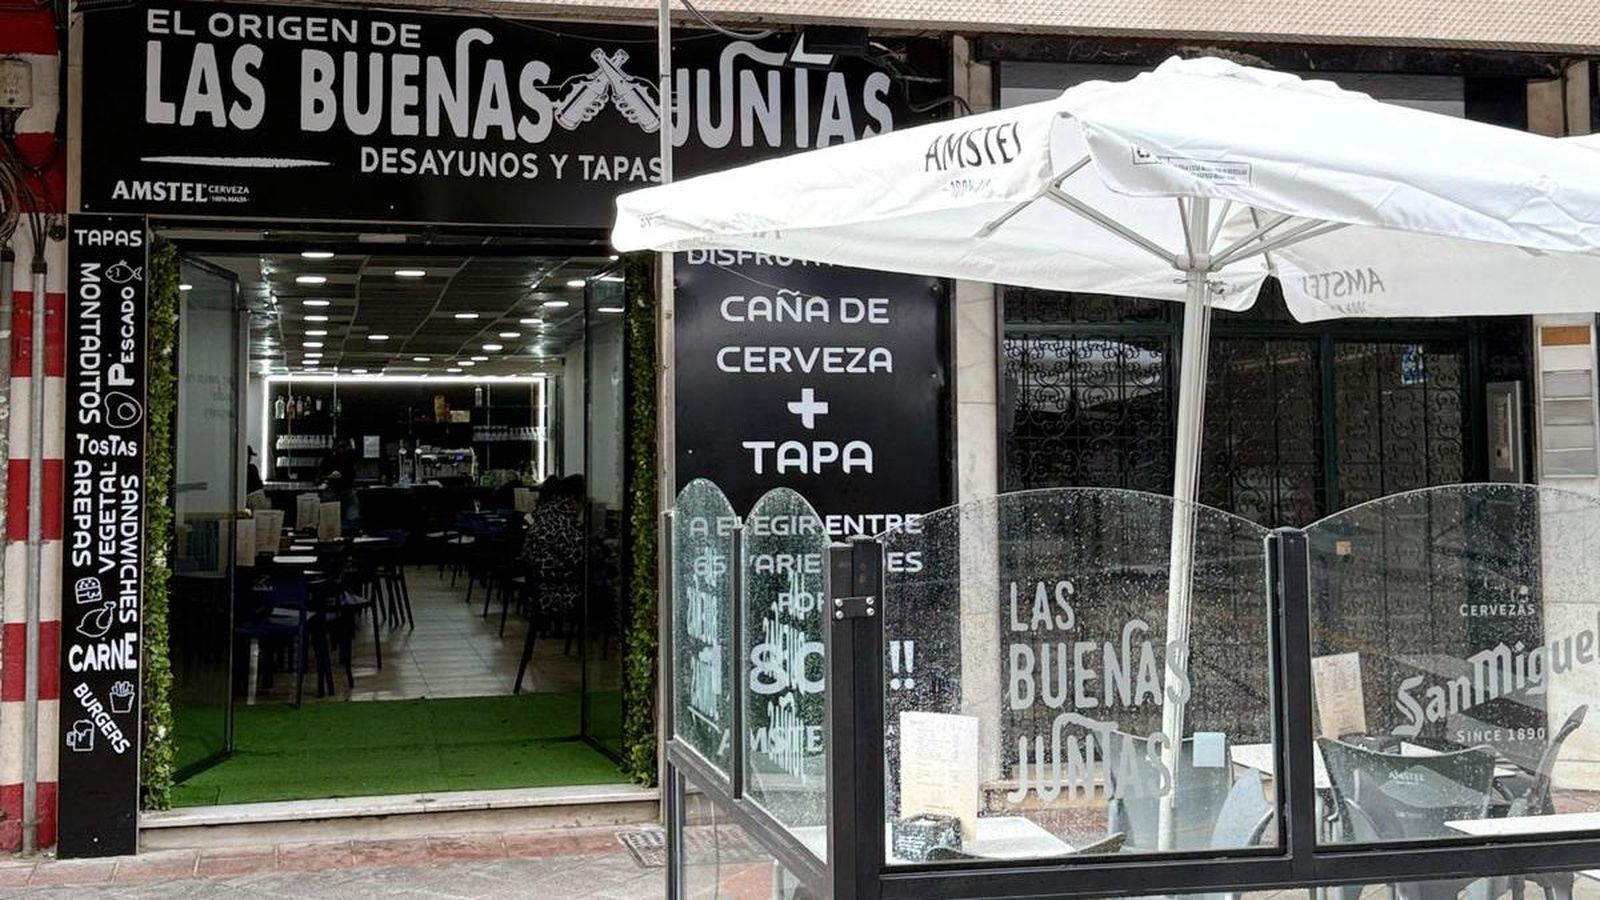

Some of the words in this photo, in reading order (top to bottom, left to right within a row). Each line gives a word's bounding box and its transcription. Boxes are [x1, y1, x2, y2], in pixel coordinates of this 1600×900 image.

[147, 9, 195, 35] EL
[208, 12, 357, 43] ORIGEN
[370, 22, 421, 48] DE
[145, 40, 266, 130] LAS
[301, 28, 553, 143] BUENAS
[361, 147, 539, 178] DESAYUNOS
[551, 154, 569, 179] Y
[579, 155, 663, 182] TAPAS
[112, 180, 208, 202] AMSTEL
[208, 185, 250, 195] CERVEZA
[74, 229, 142, 247] TAPAS
[721, 289, 830, 323] CAÑA
[840, 298, 889, 324] DE
[79, 263, 101, 424] MONTADITOS
[108, 286, 135, 386] PESCADO
[717, 346, 893, 373] CERVEZA
[742, 440, 873, 475] TAPA
[72, 460, 92, 568] AREPAS
[98, 461, 117, 574] VEGETAL
[689, 516, 708, 537] A
[825, 514, 922, 534] ENTRE
[119, 475, 139, 623] SANDWICHES
[1010, 580, 1076, 631] LAS
[68, 632, 138, 672] CARNE
[1009, 619, 1191, 711] BUENAS
[73, 682, 131, 754] BURGERS
[1456, 729, 1501, 743] SINCE
[1508, 728, 1546, 741] 1890
[1007, 712, 1171, 804] JUNTAS
